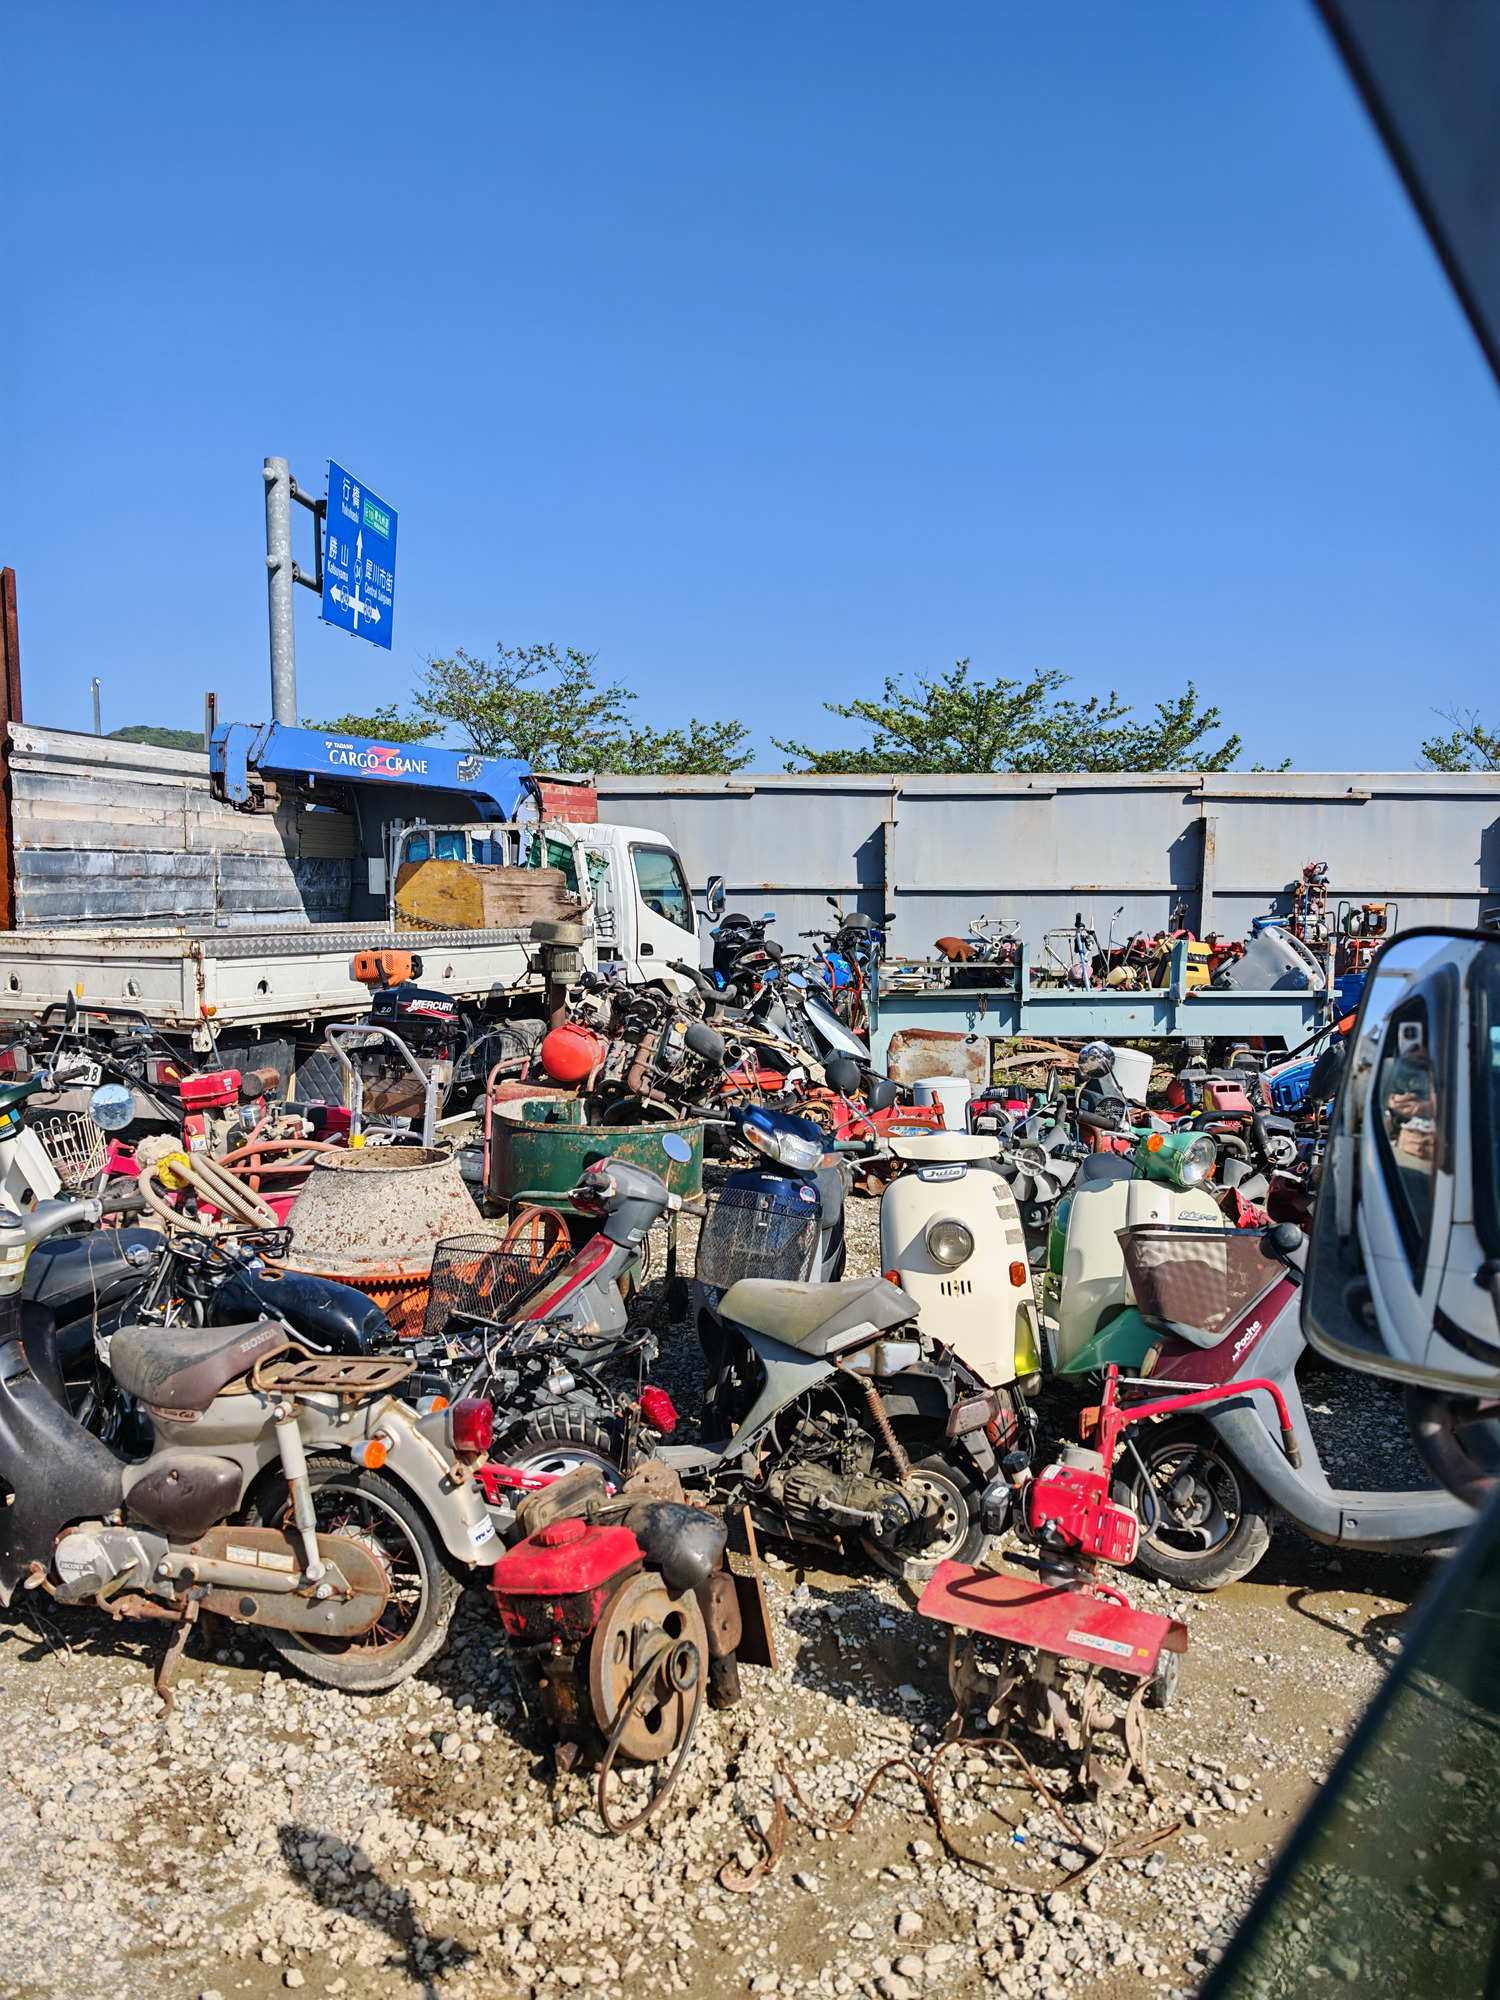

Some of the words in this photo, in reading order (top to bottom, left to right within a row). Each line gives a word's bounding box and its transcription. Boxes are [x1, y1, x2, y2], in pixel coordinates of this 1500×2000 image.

[364, 581, 378, 599] Central
[333, 742, 354, 750] TADANO
[329, 750, 379, 769] CARGO
[385, 756, 428, 774] CRANE
[405, 1000, 454, 1012] MERCURY
[761, 1174, 783, 1182] SUZUKI
[926, 1169, 961, 1178] Julio
[240, 1328, 278, 1353] HONDA
[1234, 1320, 1260, 1352] Poche
[179, 1411, 195, 1419] Cub
